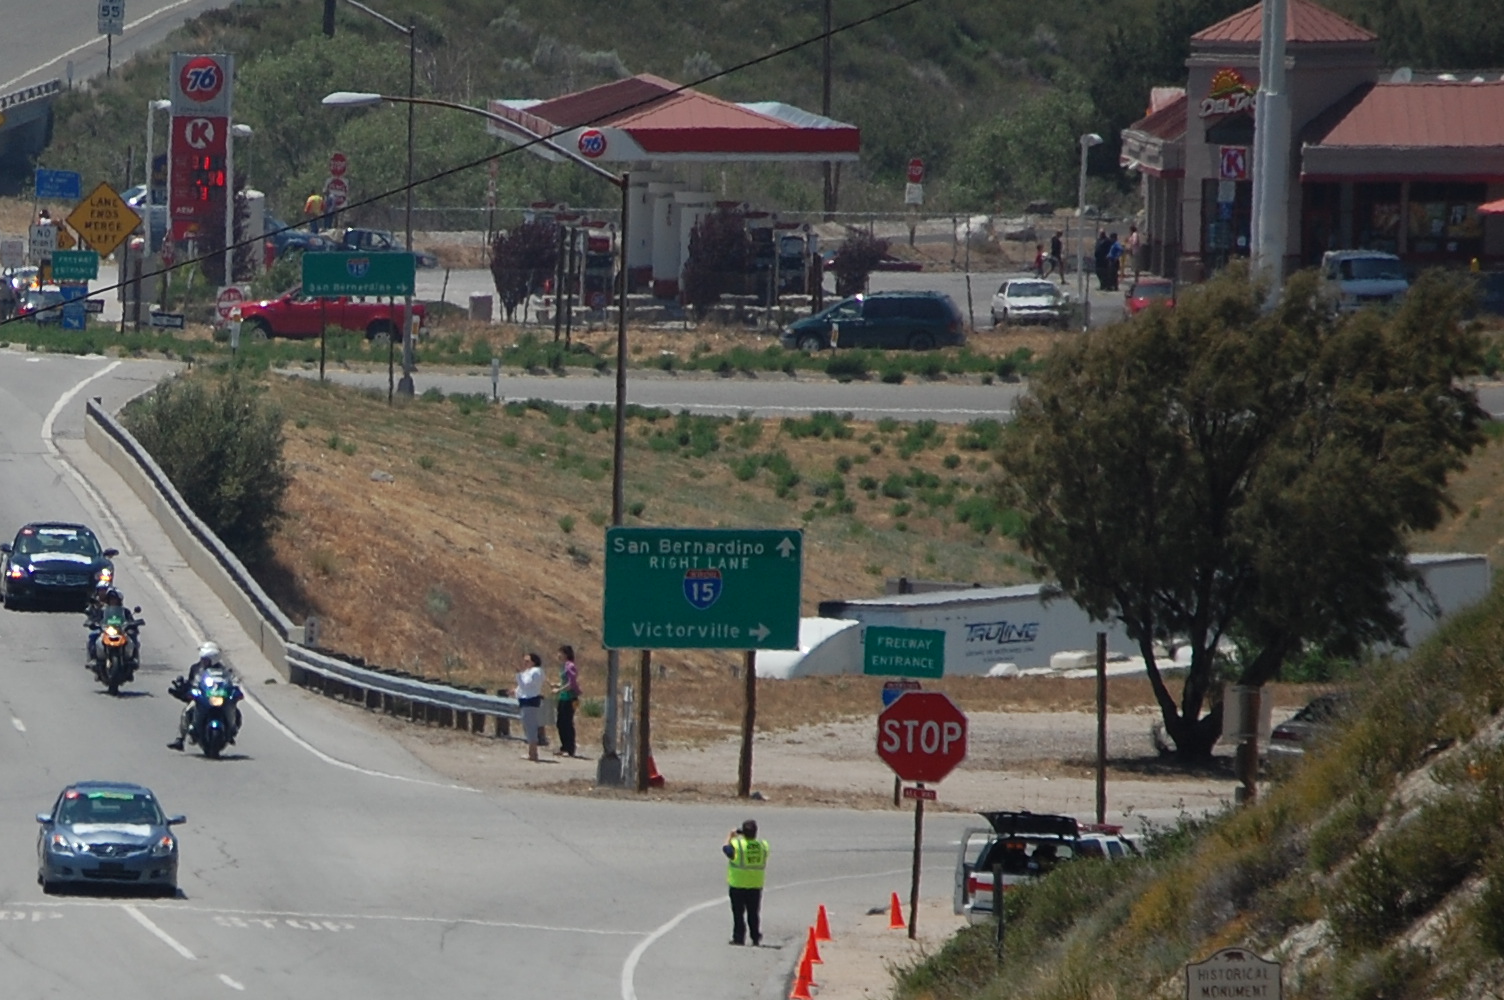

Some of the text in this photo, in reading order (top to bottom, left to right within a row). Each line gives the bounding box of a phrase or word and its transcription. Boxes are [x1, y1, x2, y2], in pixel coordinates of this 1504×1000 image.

[101, 5, 121, 18] 55
[186, 65, 216, 92] 76
[581, 135, 603, 151] 76
[89, 198, 118, 207] LANE
[89, 209, 119, 218] ENDS
[83, 220, 122, 231] MERGE
[37, 229, 51, 237] NO
[89, 233, 117, 244] LEFT
[309, 283, 330, 292] San
[613, 537, 765, 556] San Bernardino
[649, 556, 750, 570] RIGHT LANE
[692, 582, 714, 602] 15
[631, 622, 740, 639] Victorville
[877, 636, 933, 650] FREEWAY
[871, 655, 935, 669] ENTRANCE
[882, 719, 963, 755] STOP
[1197, 967, 1270, 981] HISTORICAL
[1201, 985, 1268, 998] MONUMENT
